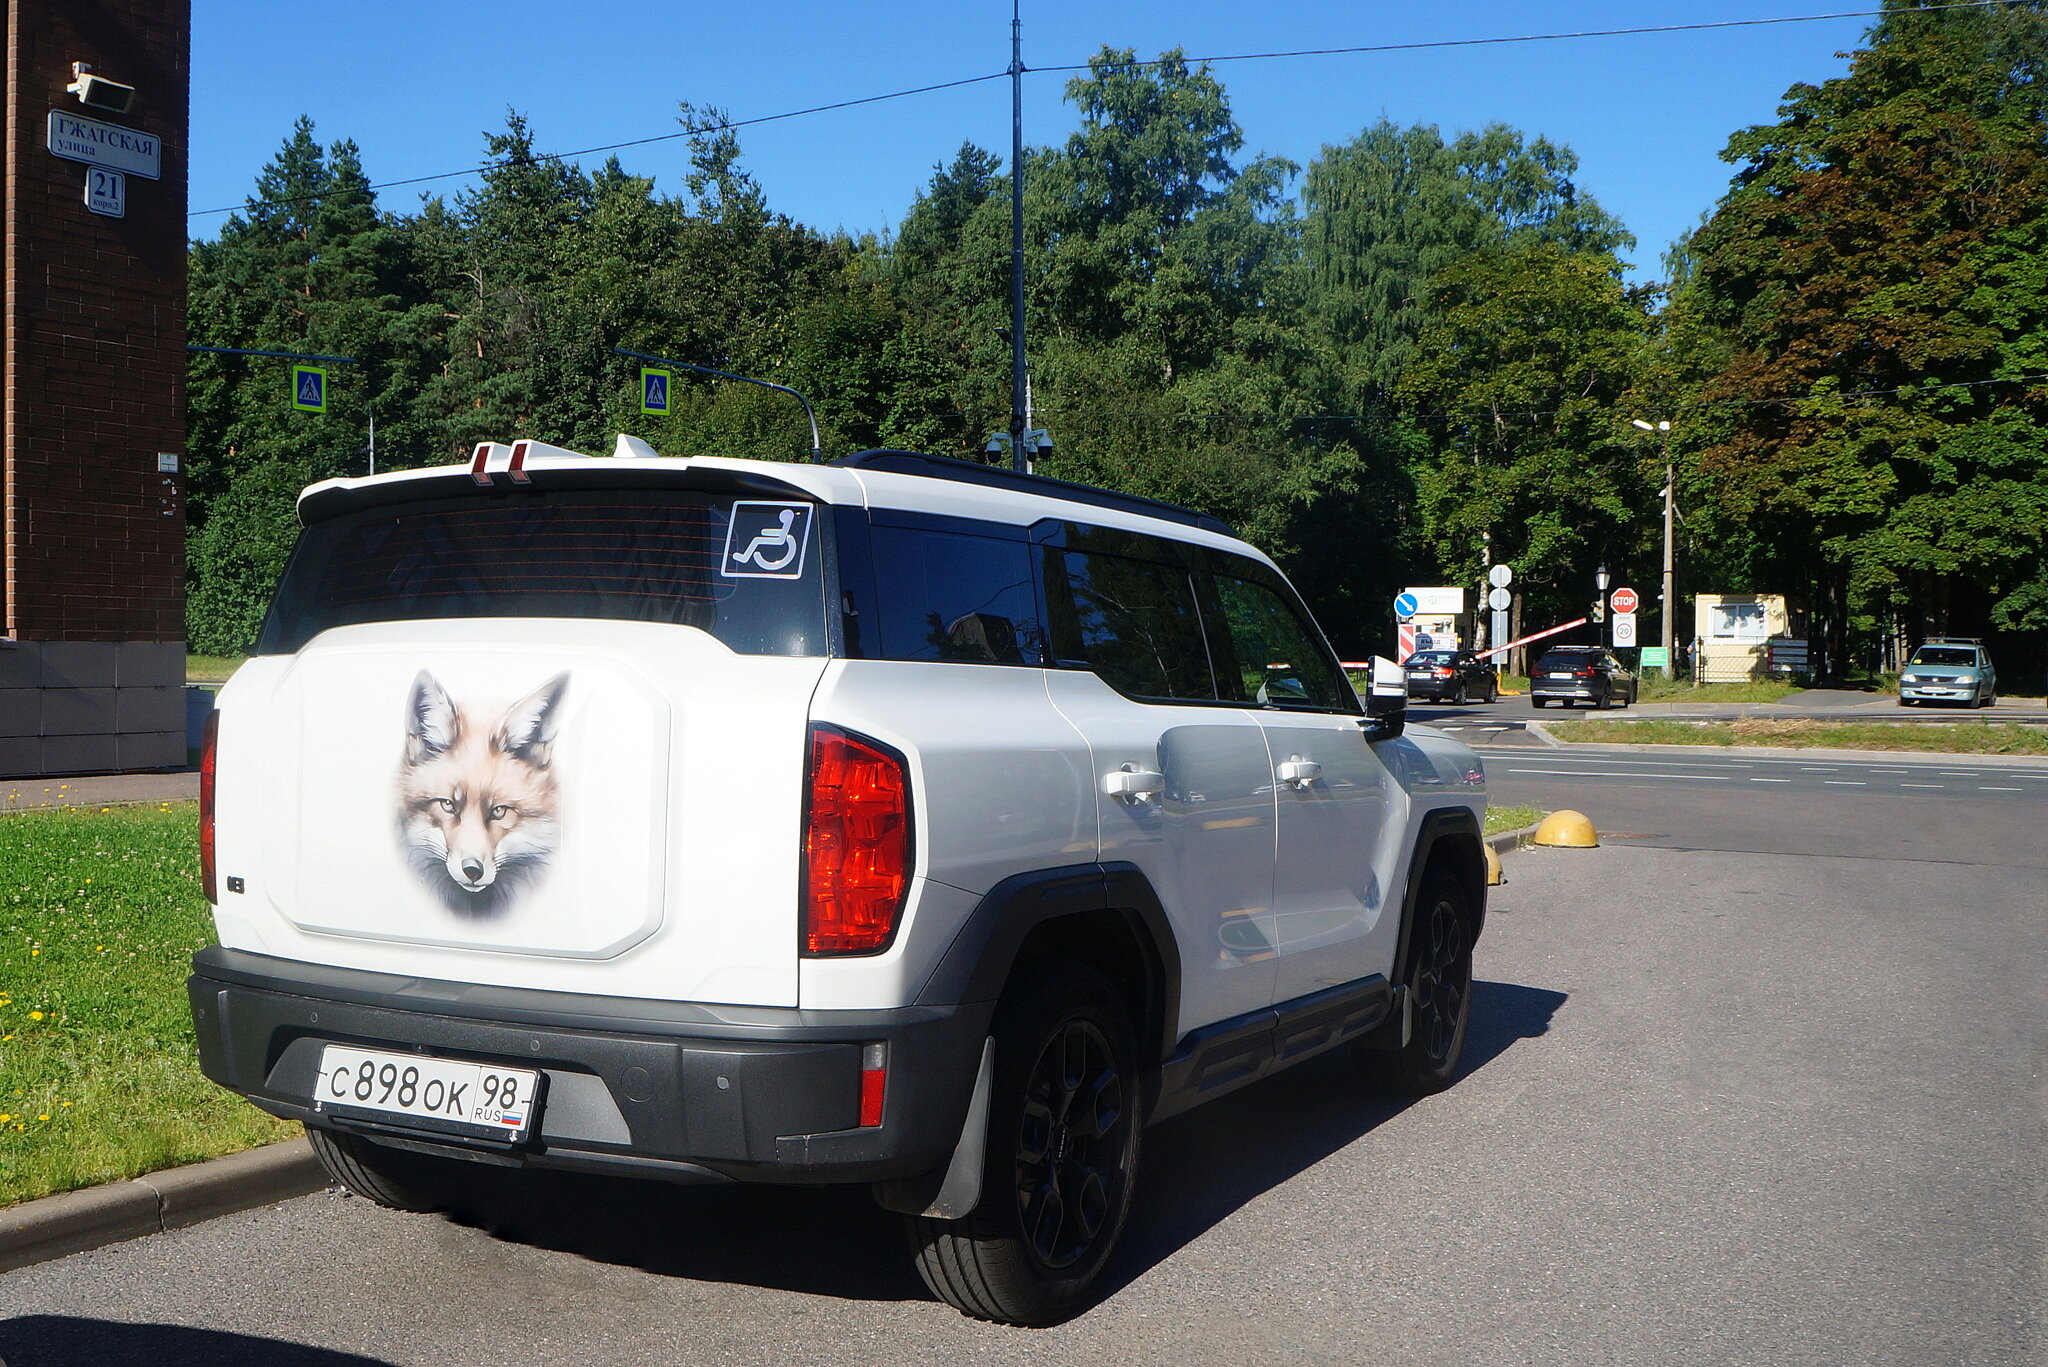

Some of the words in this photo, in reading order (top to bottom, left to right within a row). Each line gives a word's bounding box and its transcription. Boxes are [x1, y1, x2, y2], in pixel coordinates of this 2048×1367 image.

[59, 118, 153, 156] ГЖАТСКАЯ
[58, 139, 95, 156] улица
[94, 172, 117, 199] 21
[1613, 596, 1635, 606] STOP
[1619, 627, 1629, 635] 20
[483, 1074, 517, 1109] 98
[474, 1107, 501, 1122] RUS
